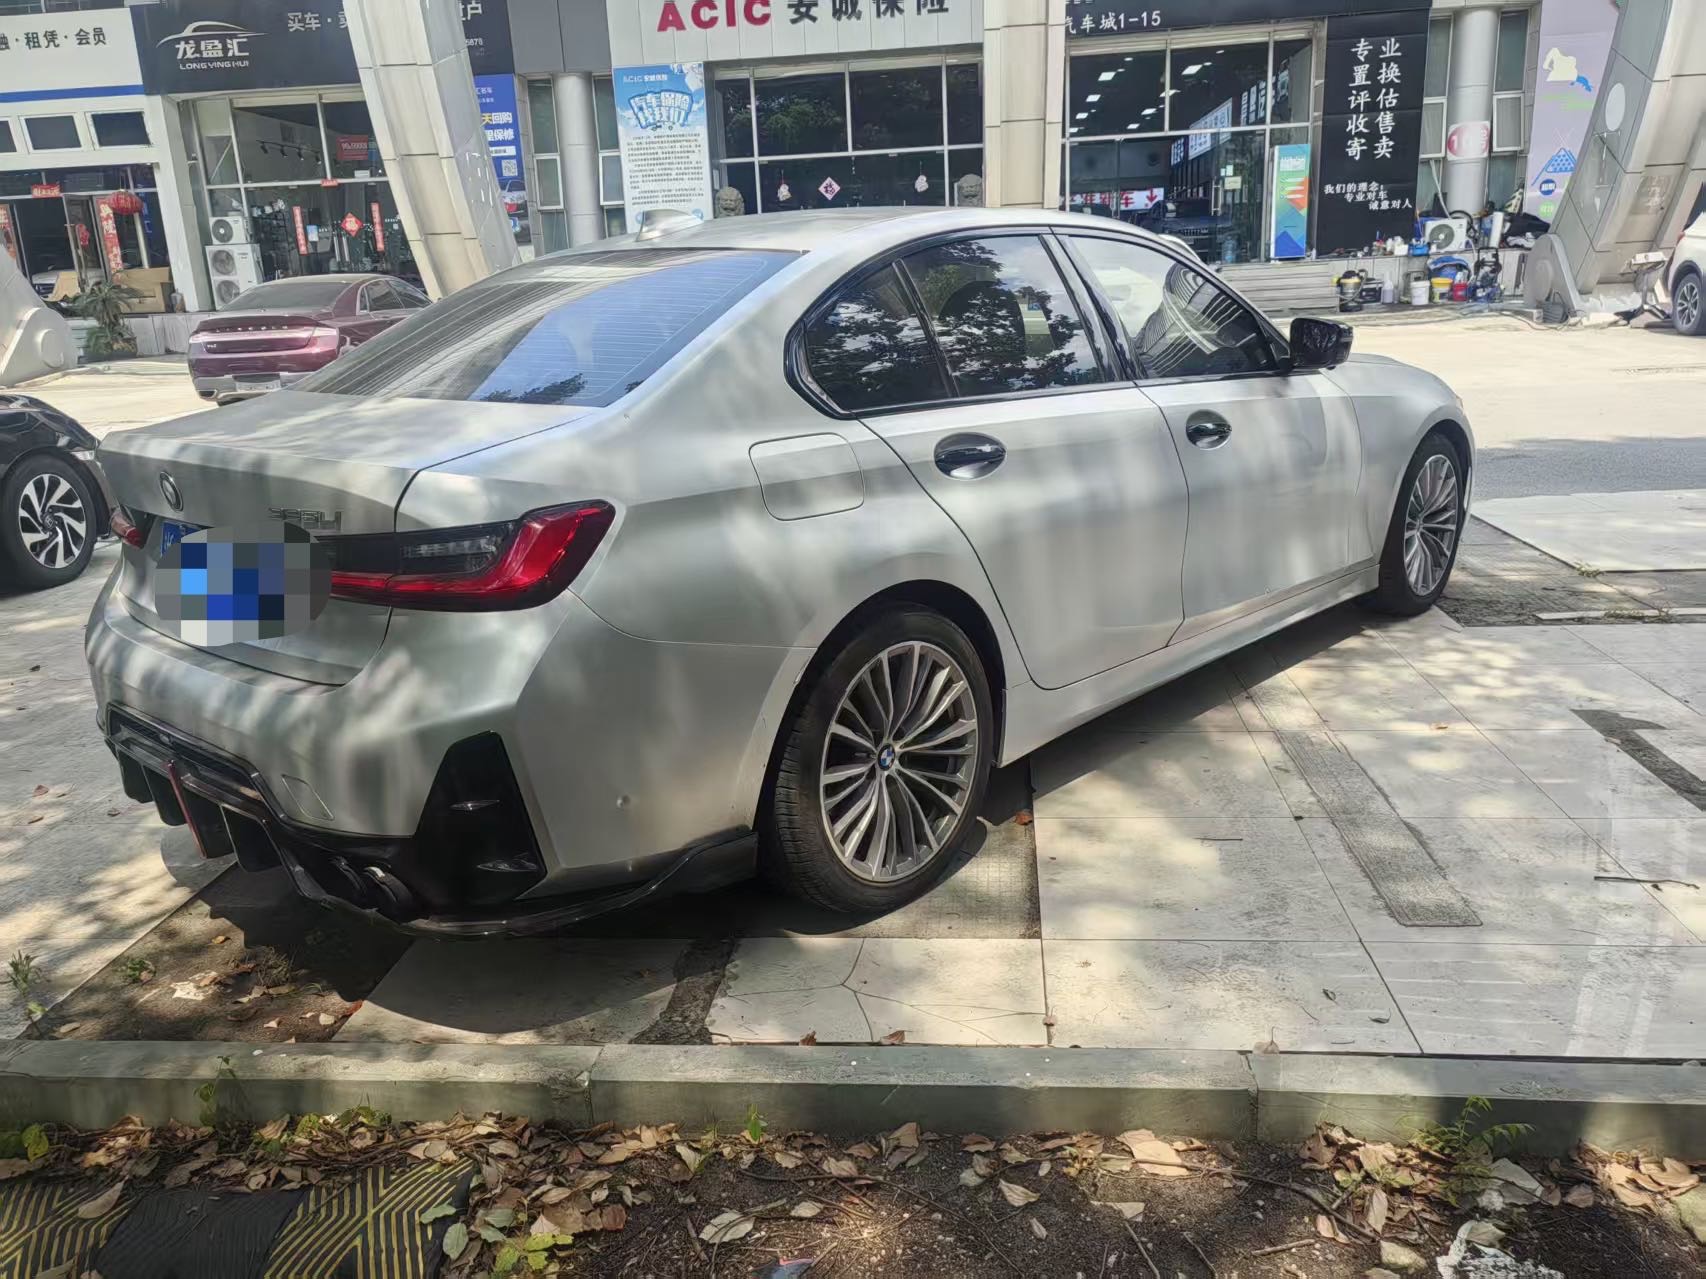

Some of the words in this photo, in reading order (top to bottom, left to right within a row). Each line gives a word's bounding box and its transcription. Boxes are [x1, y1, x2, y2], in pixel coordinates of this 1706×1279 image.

[657, 0, 771, 32] ACIC
[175, 38, 249, 60] 龙盈汇
[1344, 190, 1388, 203] 专业对车
[1369, 198, 1412, 210] 诚意对人
